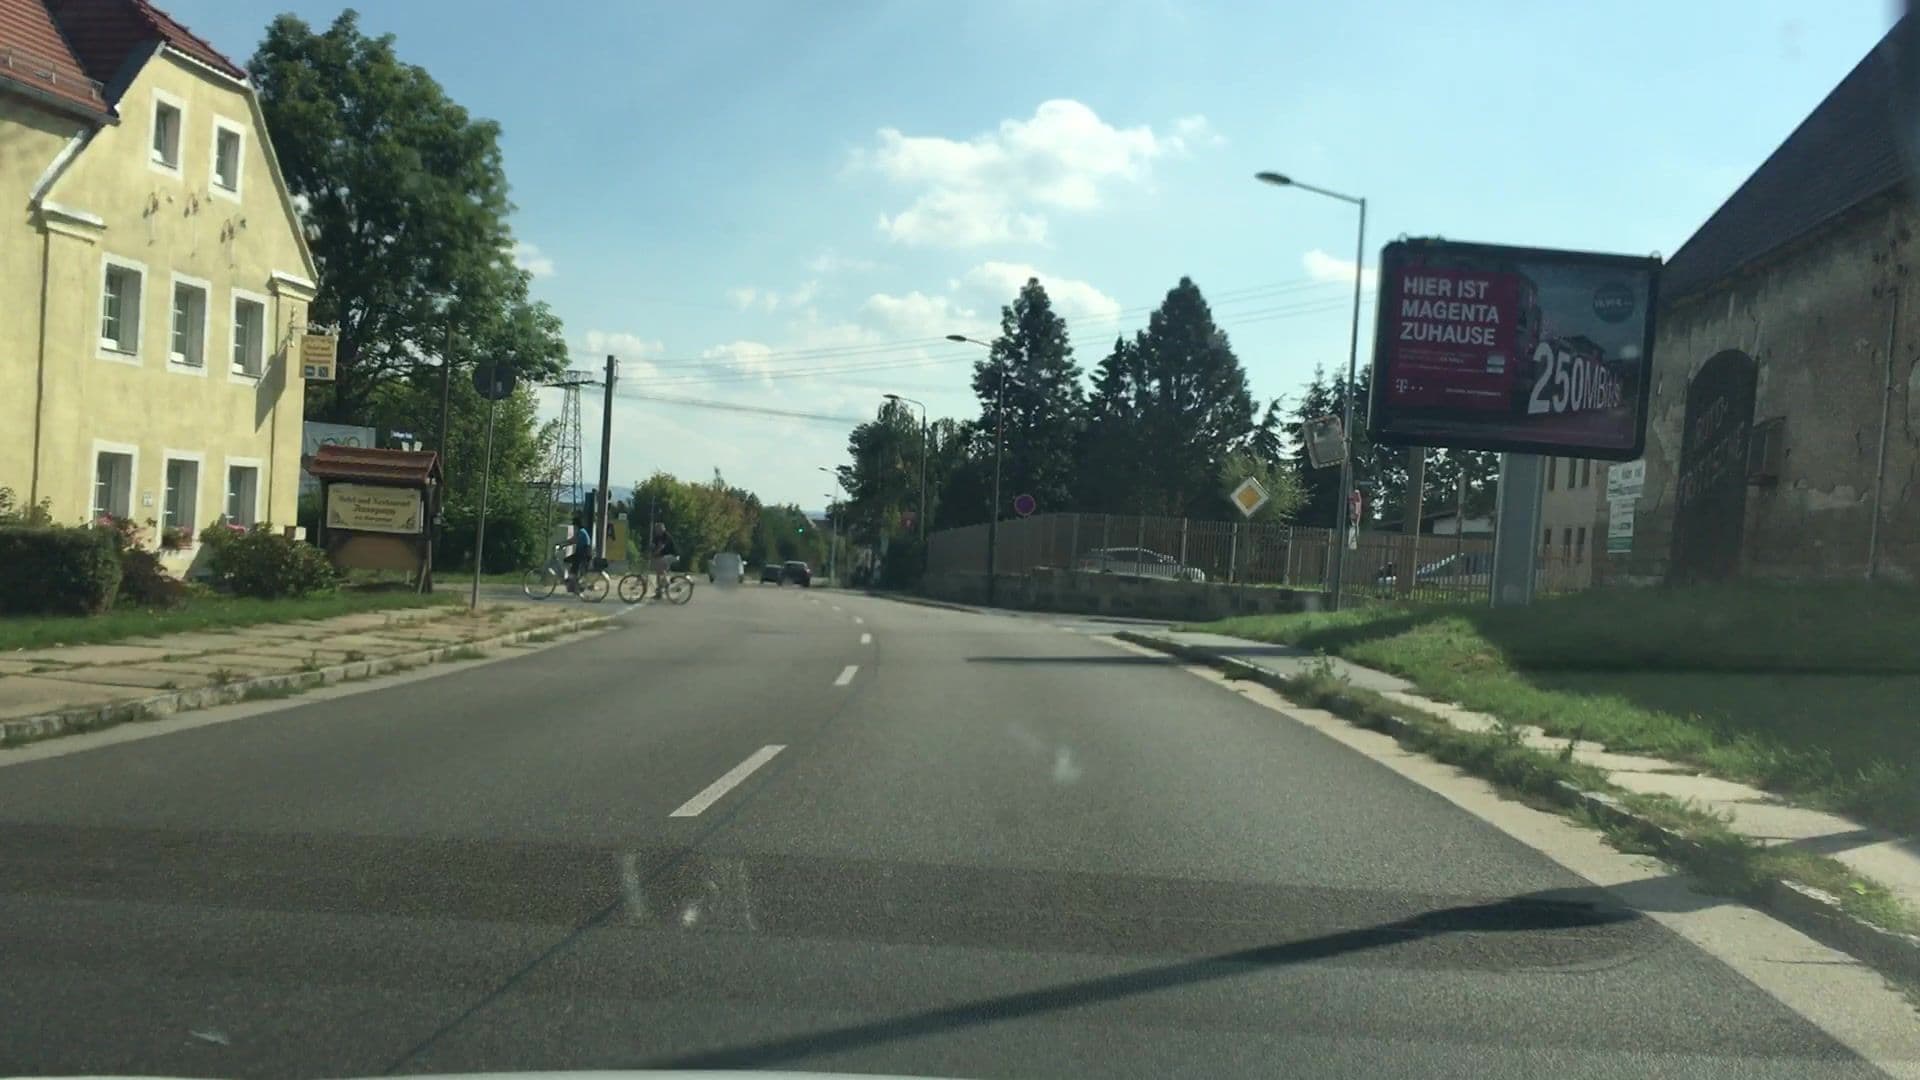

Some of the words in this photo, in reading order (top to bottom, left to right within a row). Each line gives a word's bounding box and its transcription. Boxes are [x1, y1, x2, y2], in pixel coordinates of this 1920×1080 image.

[1403, 276, 1452, 297] HIER
[1458, 279, 1490, 299] IST
[1401, 299, 1500, 325] MAGENTA
[1399, 321, 1497, 347] ZUHAUSE
